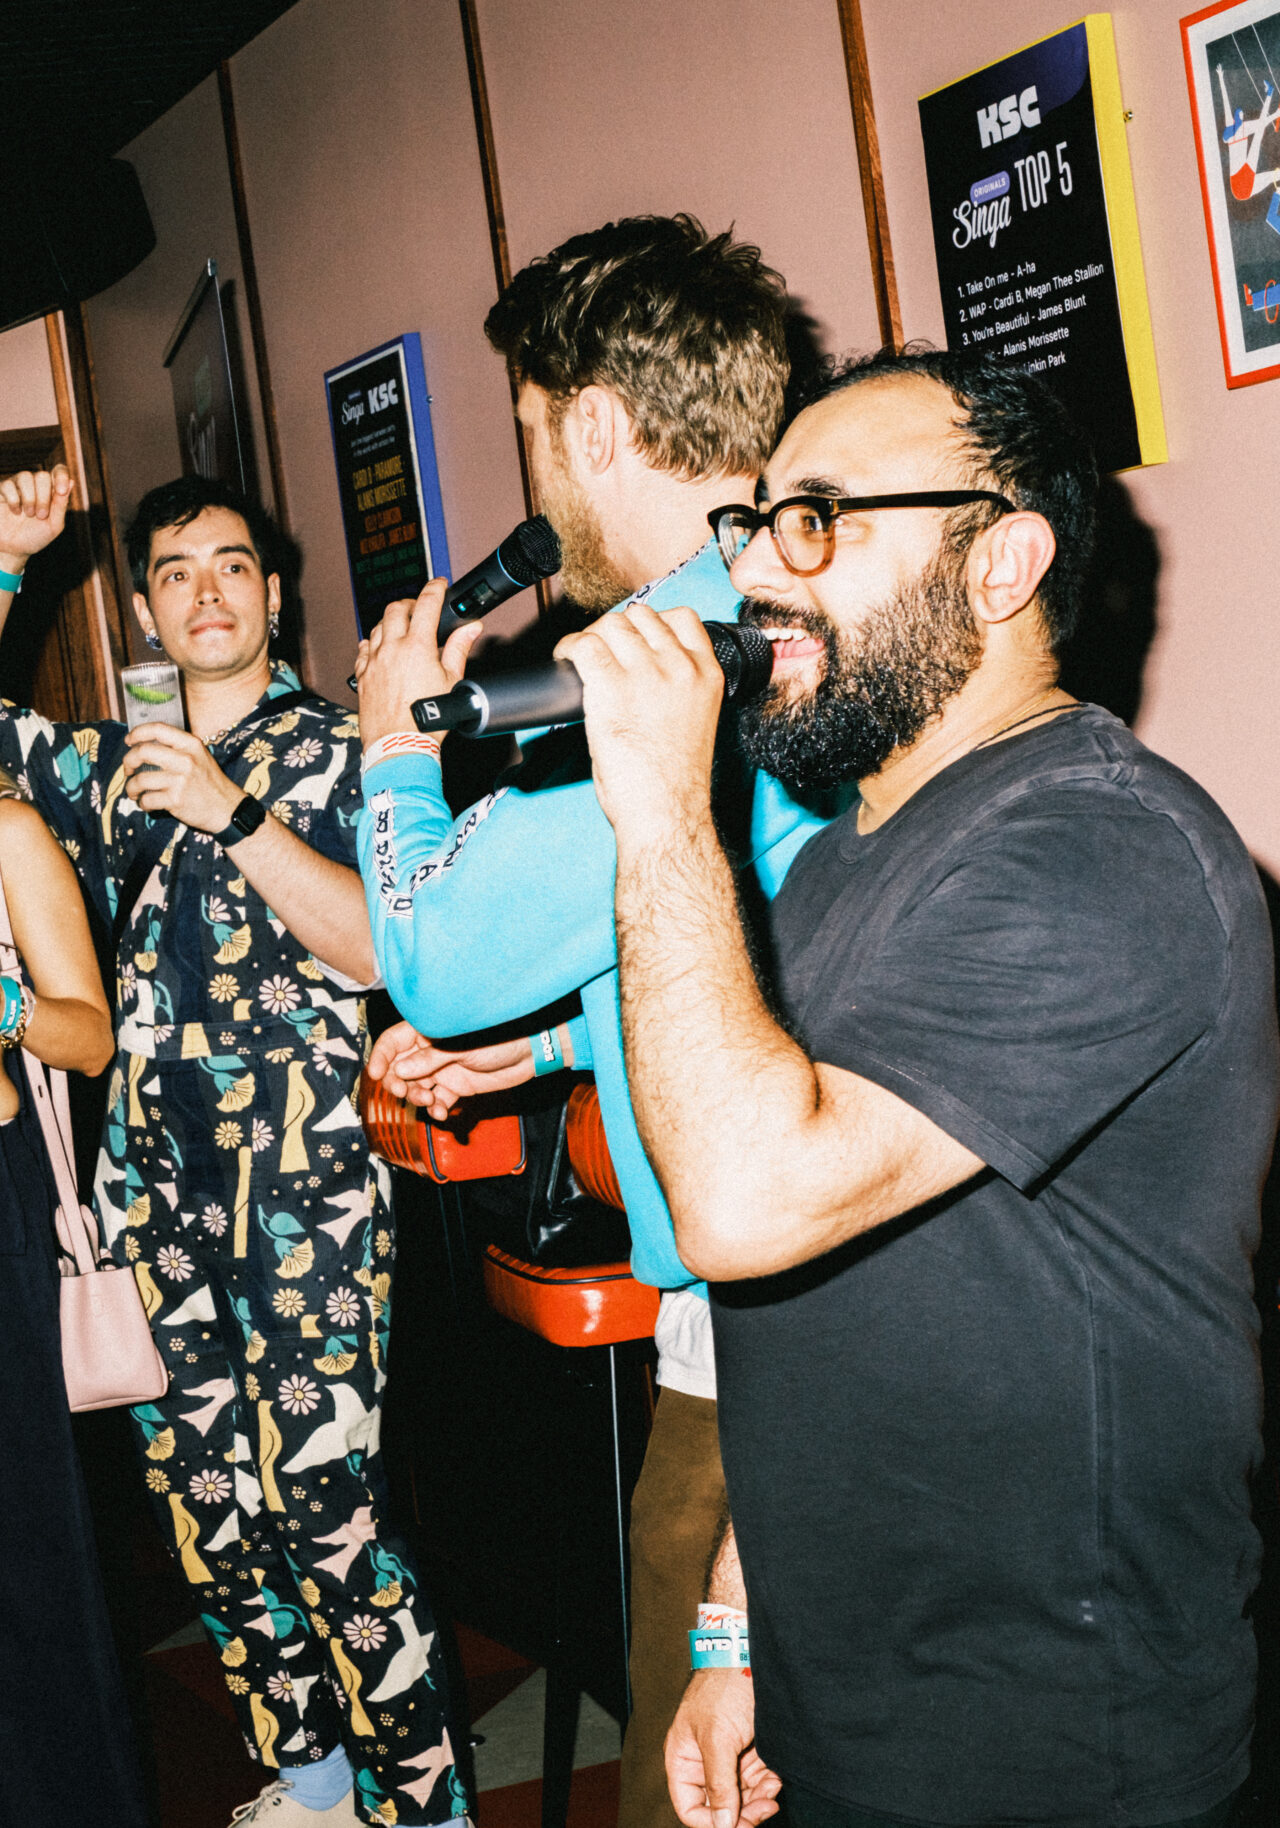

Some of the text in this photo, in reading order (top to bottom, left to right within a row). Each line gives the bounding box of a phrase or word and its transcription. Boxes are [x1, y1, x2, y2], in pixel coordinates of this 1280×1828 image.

[977, 85, 1041, 148] KSC
[973, 177, 1006, 198] ORIGINALS
[1014, 141, 1073, 211] TOP 5
[952, 195, 1011, 248] Singa
[958, 286, 965, 298] 1.
[966, 282, 983, 296] Take
[984, 276, 996, 289] On
[997, 272, 1009, 286] me
[1017, 261, 1036, 277] A-ha
[959, 309, 968, 322] 2.
[969, 302, 987, 319] WAP
[993, 292, 1014, 311] Cardi
[1015, 289, 1024, 303] B,
[1025, 282, 1052, 300] Megan
[1052, 274, 1073, 290] Thee
[1074, 263, 1104, 283] Stallion
[962, 332, 971, 345] 3.
[972, 326, 994, 342] You're
[995, 312, 1030, 333] Beautiful
[1037, 303, 1063, 321] James
[1064, 294, 1087, 312] Blunt
[1003, 339, 1027, 357] Alanis
[1028, 327, 1069, 349] Morissette
[1047, 350, 1066, 368] Park
[367, 379, 399, 414] KSC
